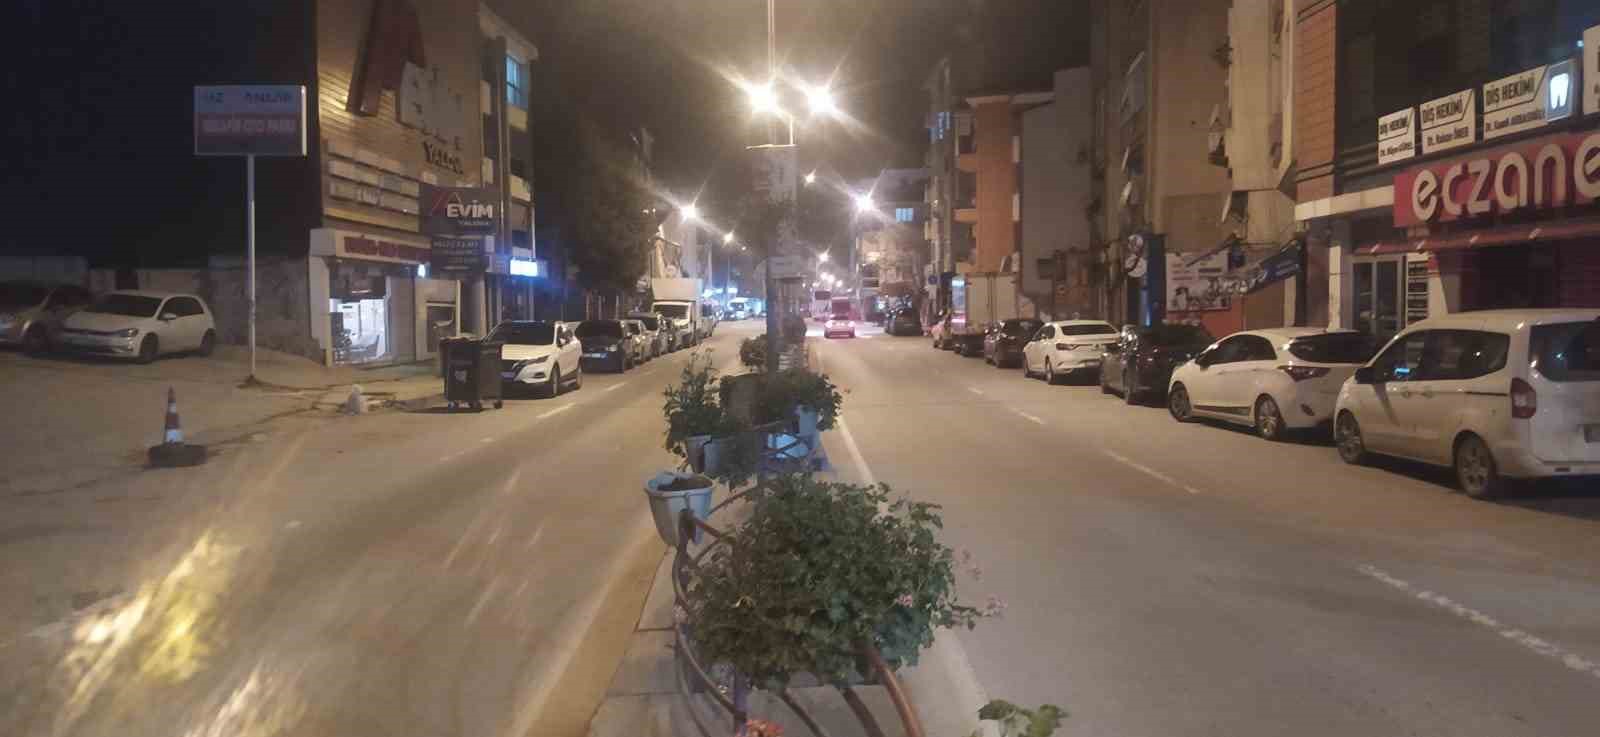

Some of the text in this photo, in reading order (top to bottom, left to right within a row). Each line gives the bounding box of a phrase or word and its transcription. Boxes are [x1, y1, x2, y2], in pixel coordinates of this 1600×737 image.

[1502, 73, 1535, 100] HEKİMİ
[1436, 95, 1463, 120] HEKİMİ
[1411, 131, 1600, 221] eczane
[447, 200, 494, 218] EVİM
